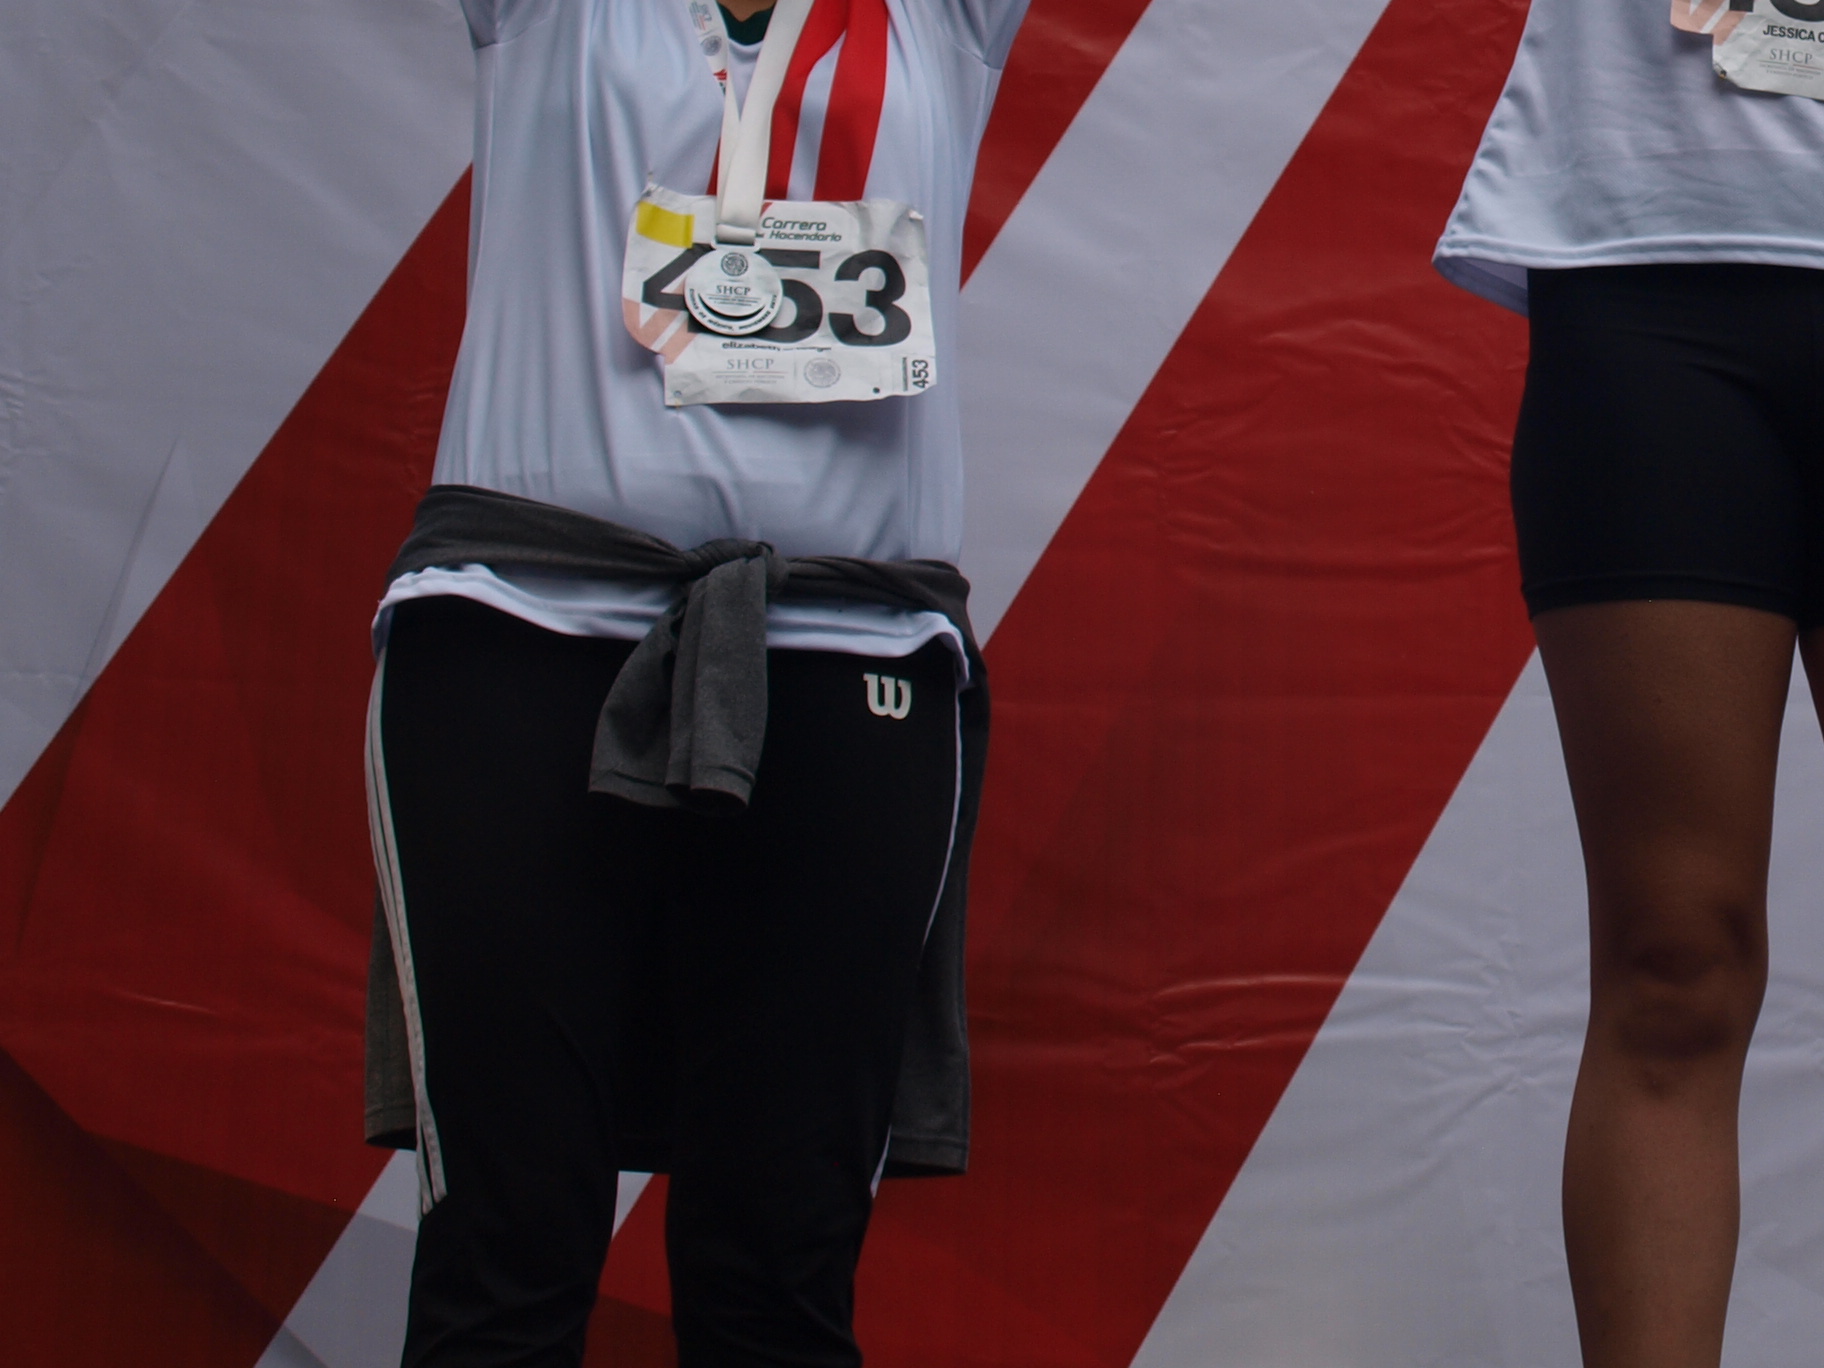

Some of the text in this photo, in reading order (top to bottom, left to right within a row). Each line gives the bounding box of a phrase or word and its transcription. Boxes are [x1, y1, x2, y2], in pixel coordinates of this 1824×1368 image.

[1763, 25, 1816, 42] JESSICA
[1769, 48, 1813, 65] SHCP
[762, 216, 827, 232] Carrera
[769, 230, 842, 242] Hacendario
[716, 285, 752, 297] SHCP
[726, 358, 775, 371] SHCP
[912, 359, 929, 390] 453
